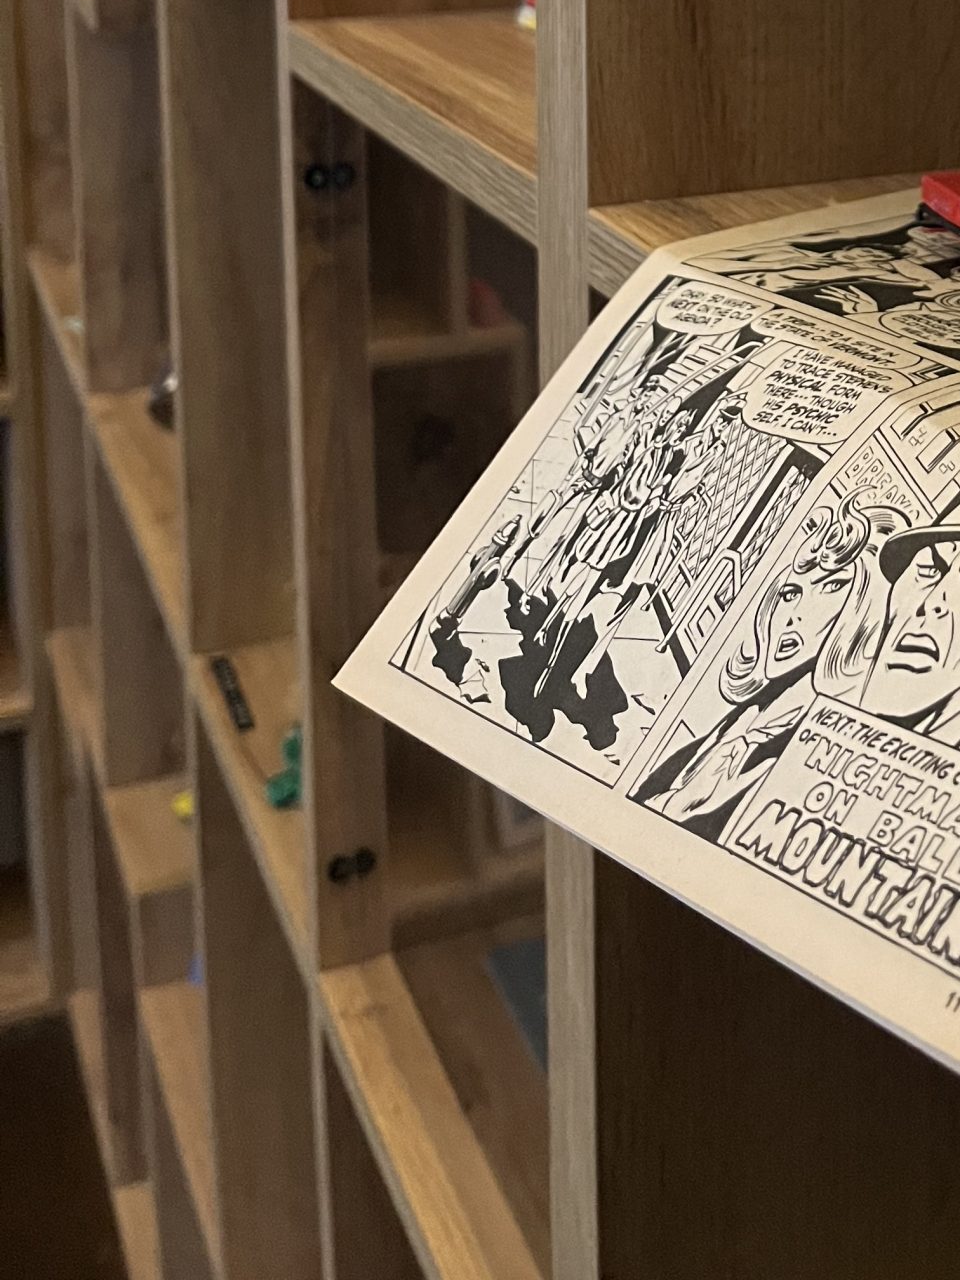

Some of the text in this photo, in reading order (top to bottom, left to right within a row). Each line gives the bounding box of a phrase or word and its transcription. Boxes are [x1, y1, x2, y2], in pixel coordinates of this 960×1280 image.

[758, 318, 896, 367] THE STATE OF VERMONT.
[827, 330, 843, 338] TO
[850, 340, 886, 353] SITE
[782, 359, 796, 370] TO
[796, 362, 836, 379] TRACE
[793, 349, 893, 381] I HAVE MANAGED
[763, 383, 857, 414] THERE... THOUGH
[765, 370, 862, 400] PHYSICAL FORM
[762, 398, 840, 424] HIS PSYCHIC
[781, 418, 793, 427] I
[799, 728, 821, 744] OF
[811, 706, 856, 736] NEXT:
[851, 722, 883, 750] THE
[876, 736, 955, 780] EXCITING
[803, 781, 859, 827] ON
